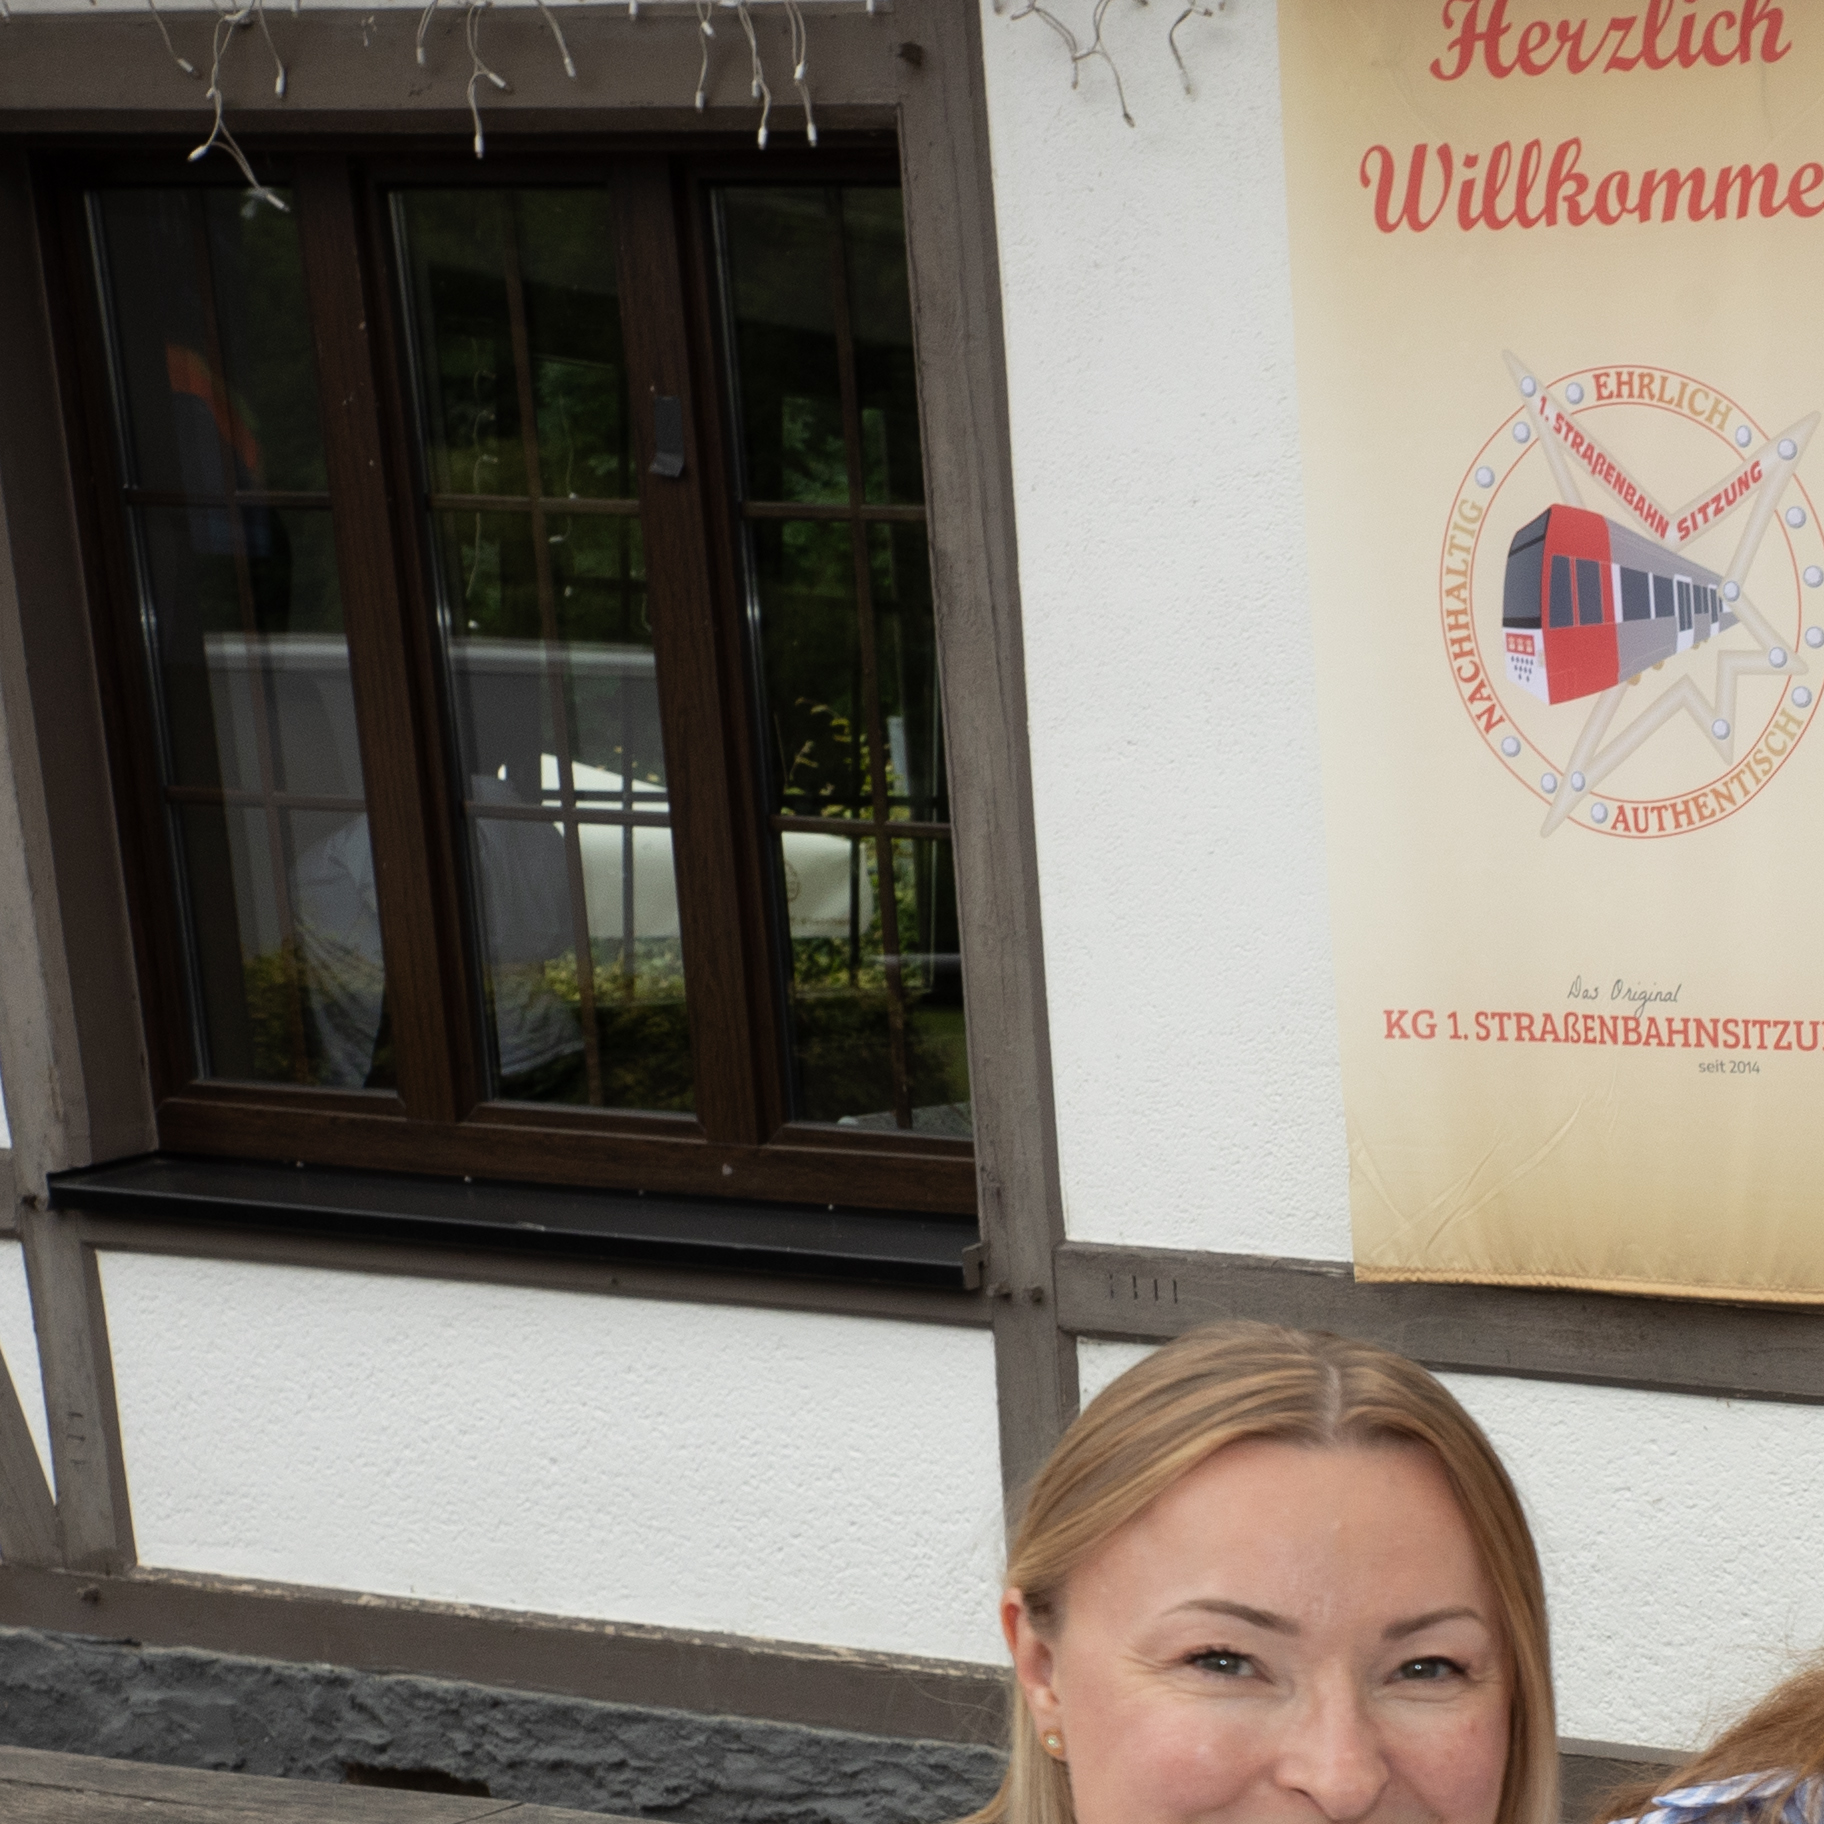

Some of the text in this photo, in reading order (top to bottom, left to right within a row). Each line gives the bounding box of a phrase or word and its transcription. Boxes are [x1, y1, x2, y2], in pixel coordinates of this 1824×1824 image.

[1429, 0, 1792, 81] Herzlich
[1592, 370, 1734, 433] EHRLICH
[1676, 460, 1764, 542] SITZUNG
[1444, 498, 1506, 735] NACHHALTIG
[1610, 706, 1804, 835] AUTHENTISCH
[1384, 1010, 1437, 1041] KG
[1567, 975, 1683, 1017] Das Original
[1698, 1060, 1761, 1075] seit 2014
